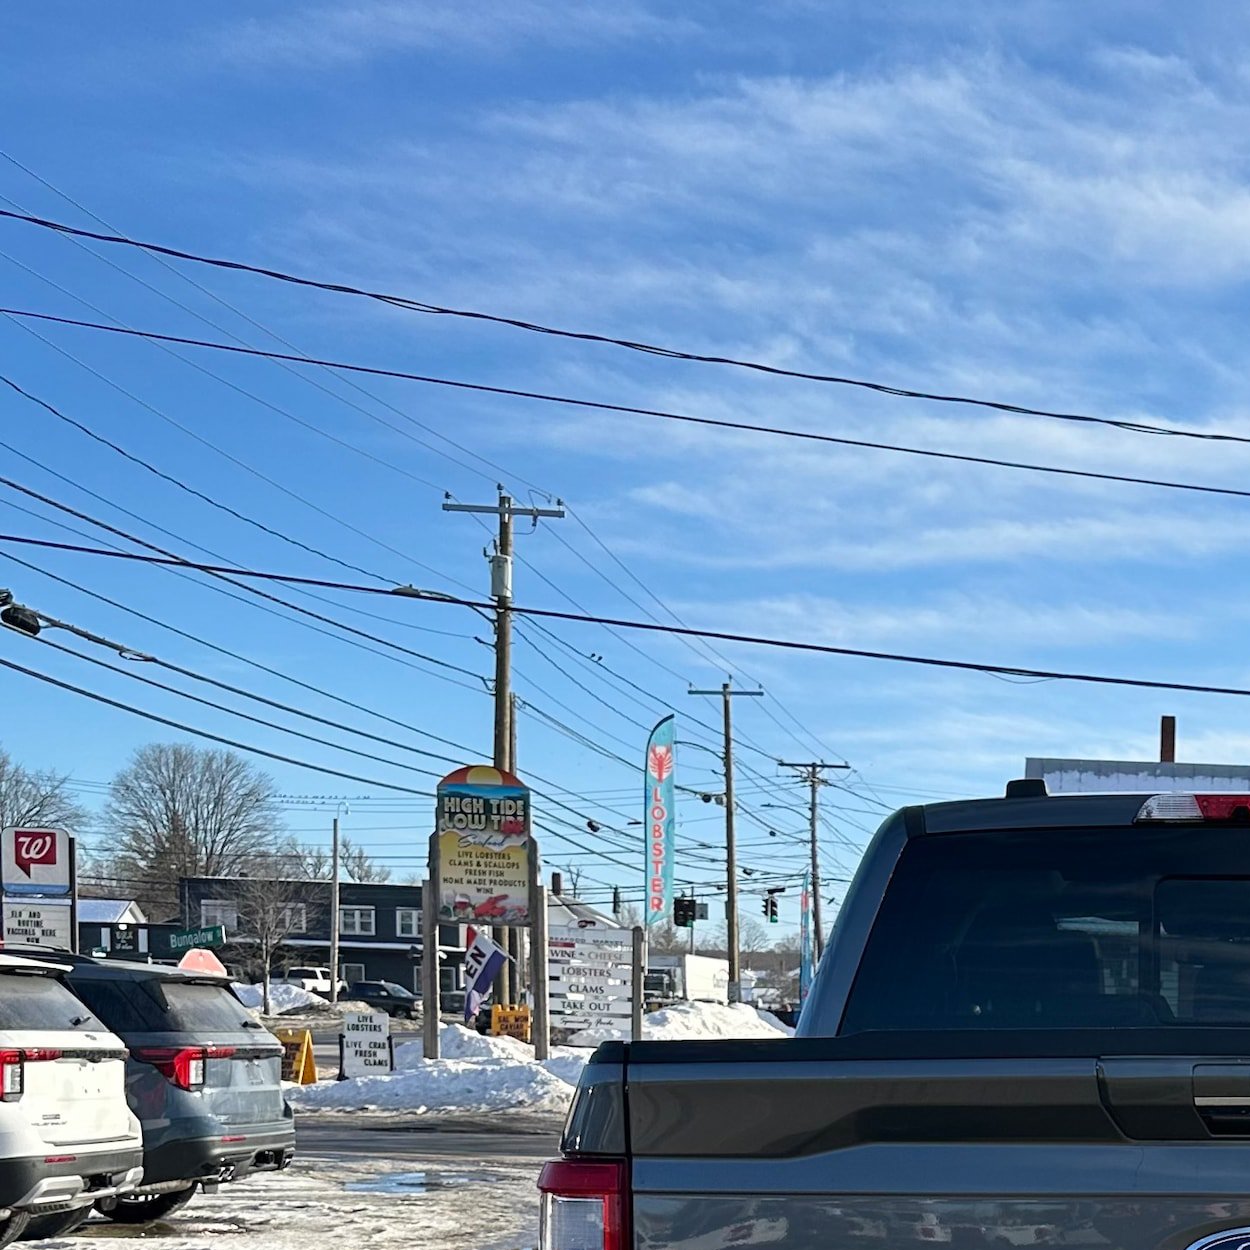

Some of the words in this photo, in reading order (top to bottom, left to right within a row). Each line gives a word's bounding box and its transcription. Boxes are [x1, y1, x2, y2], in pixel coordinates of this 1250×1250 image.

[444, 797, 484, 813] HIGH
[490, 799, 524, 815] TIDE
[444, 814, 486, 831] LOW
[650, 787, 666, 912] LOBSTER
[475, 852, 511, 860] LOBSTERS
[170, 929, 213, 948] Bungalow
[550, 950, 577, 958] WINE
[588, 951, 624, 960] CHEESE
[562, 967, 612, 977] LOBSTERS
[568, 984, 604, 994] CLAMS
[561, 1001, 584, 1010] TAKE
[589, 1003, 612, 1011] OUT
